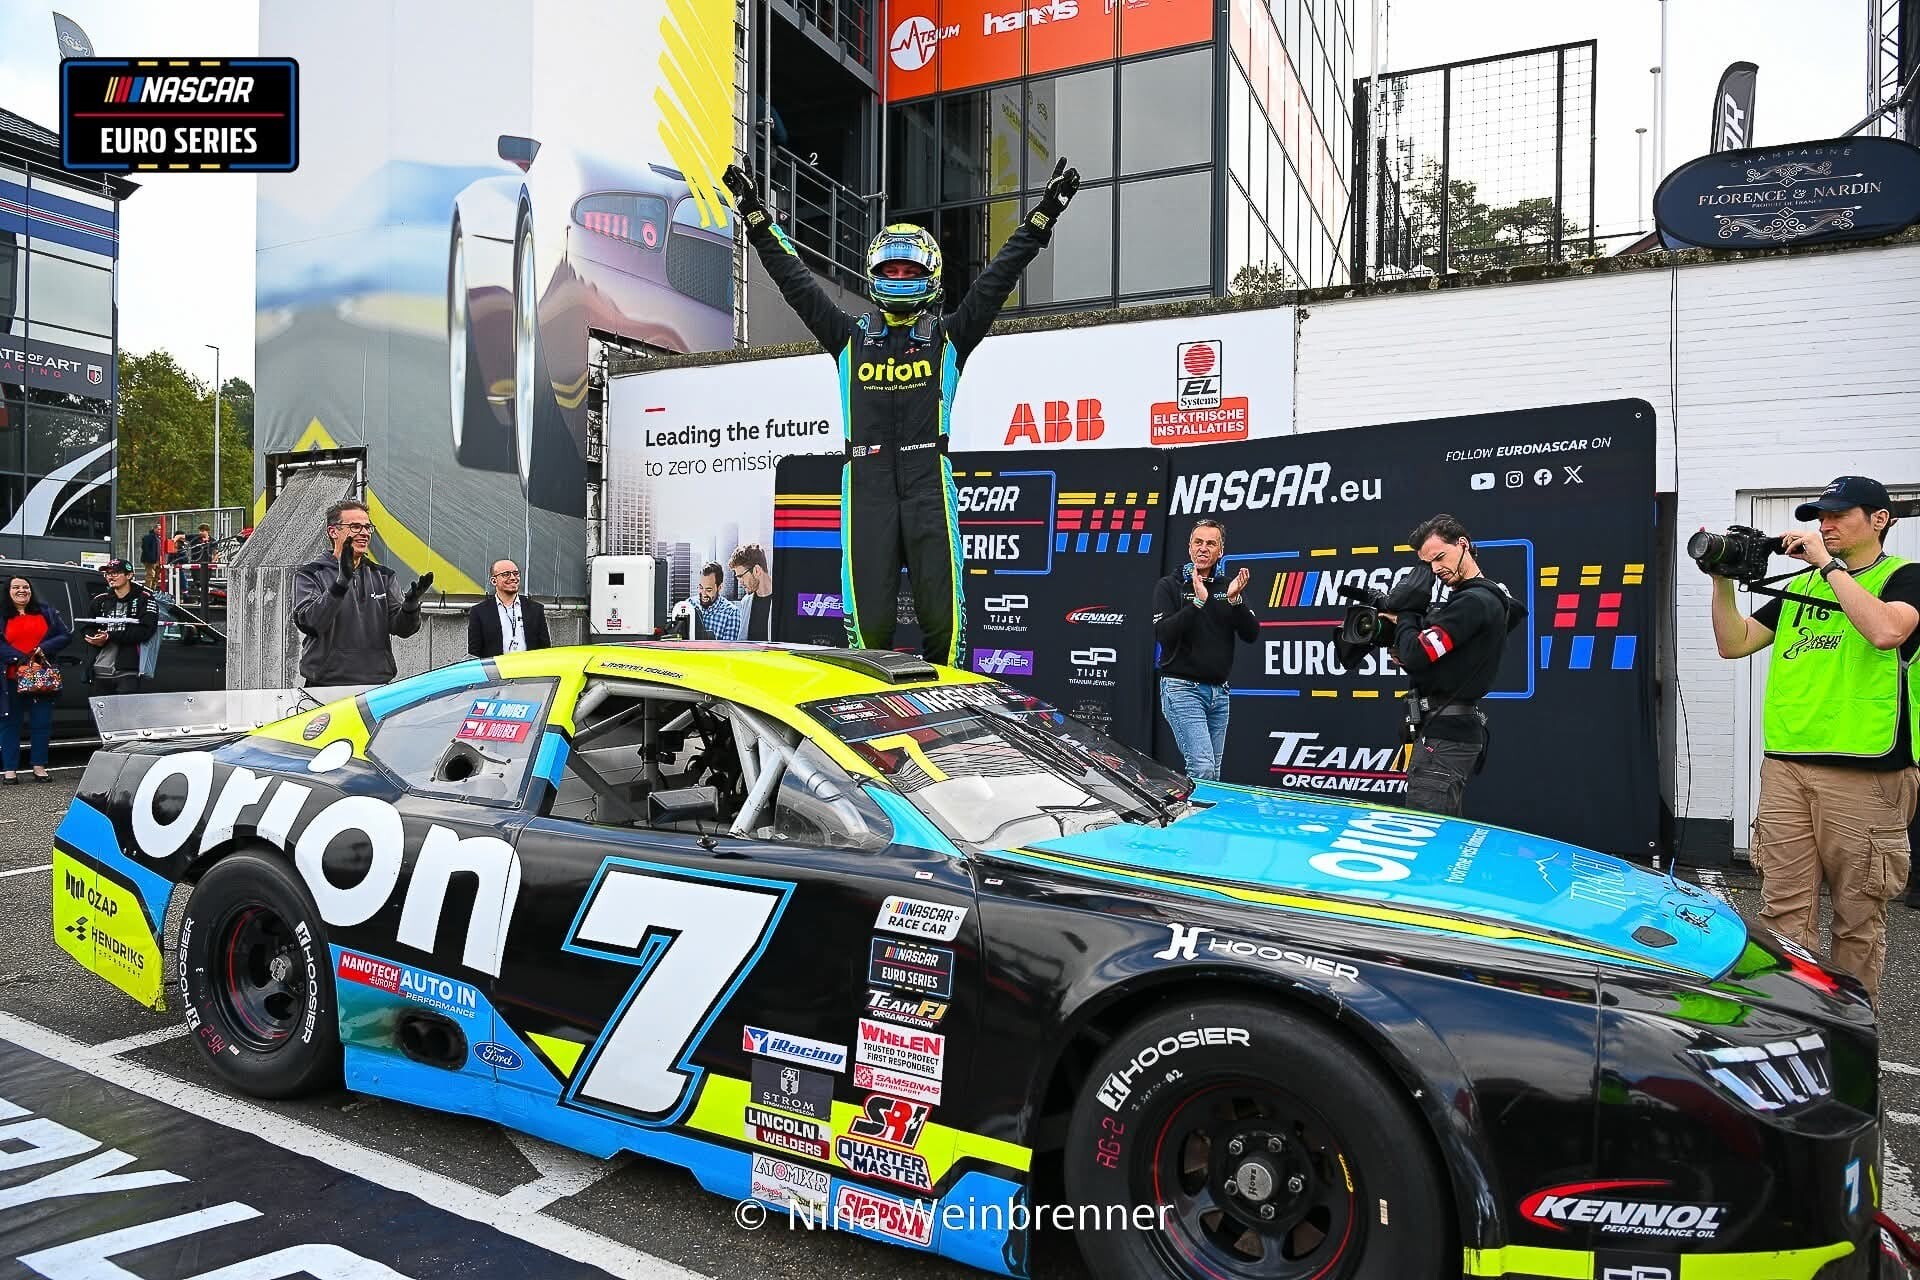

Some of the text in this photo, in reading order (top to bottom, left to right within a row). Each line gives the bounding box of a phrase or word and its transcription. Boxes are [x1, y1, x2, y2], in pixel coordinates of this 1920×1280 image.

[1698, 182, 1882, 205] FLORENCE & NARDIN
[28, 353, 43, 362] OF
[44, 357, 81, 372] ART
[858, 357, 932, 382] orion
[1182, 379, 1218, 396] EL
[1180, 396, 1219, 408] Systems
[1004, 398, 1105, 445] ABB
[1153, 408, 1245, 425] ELEKTRISCHE
[1153, 421, 1245, 438] INSTALLATIES
[645, 418, 830, 448] Leading the future
[1445, 436, 1612, 463] FOLLOW EURONASCAR ON
[645, 460, 663, 477] to
[668, 459, 707, 476] zero
[961, 534, 1020, 561] ERIES
[990, 615, 1021, 624] TIJEY
[1070, 612, 1124, 623] KENNOL
[978, 656, 1029, 667] HOOSIER
[1077, 668, 1108, 678] TIJEY
[132, 740, 522, 977] orion
[1302, 811, 1447, 882] orion
[88, 888, 117, 917] OZAP
[907, 902, 953, 923] NASCAR
[888, 915, 946, 935] RACE CAR
[92, 926, 144, 970] HENDRIKS
[897, 947, 939, 967] NASCAR
[1208, 937, 1360, 983] HOOSIER
[179, 917, 195, 1008] HOOSIER
[341, 954, 399, 981] NANOTECH
[400, 970, 477, 1009] AUTO IN
[881, 966, 938, 989] EURO SERIES
[301, 945, 318, 1044] HOOSIER
[567, 862, 789, 1121] 7
[406, 992, 476, 1018] PERFORMANCE
[872, 1010, 934, 1029] ORGANIZATION
[770, 1037, 844, 1066] iRacing
[861, 1021, 941, 1056] WHELEN
[482, 1044, 513, 1066] Ford
[863, 1042, 939, 1066] TRUSTED TO PROTECT
[867, 1052, 935, 1075] FIRST RESPONDERS
[1119, 1027, 1250, 1084] HOOSIER
[874, 1073, 940, 1096] SAMSONAS
[874, 1081, 921, 1096] MOTORSPORT
[763, 1091, 815, 1112] STROM
[748, 1109, 815, 1139] LINCOLN
[851, 1096, 929, 1148] SRI
[763, 1130, 821, 1157] WELDERS
[837, 1138, 925, 1173] QUARTER
[853, 1158, 928, 1188] MASTER
[1844, 1158, 1860, 1215] 7
[842, 1193, 926, 1239] SIMPSON
[1534, 1197, 1721, 1230] KENNOL
[1601, 1224, 1716, 1238] PERFORMANCE OIL
